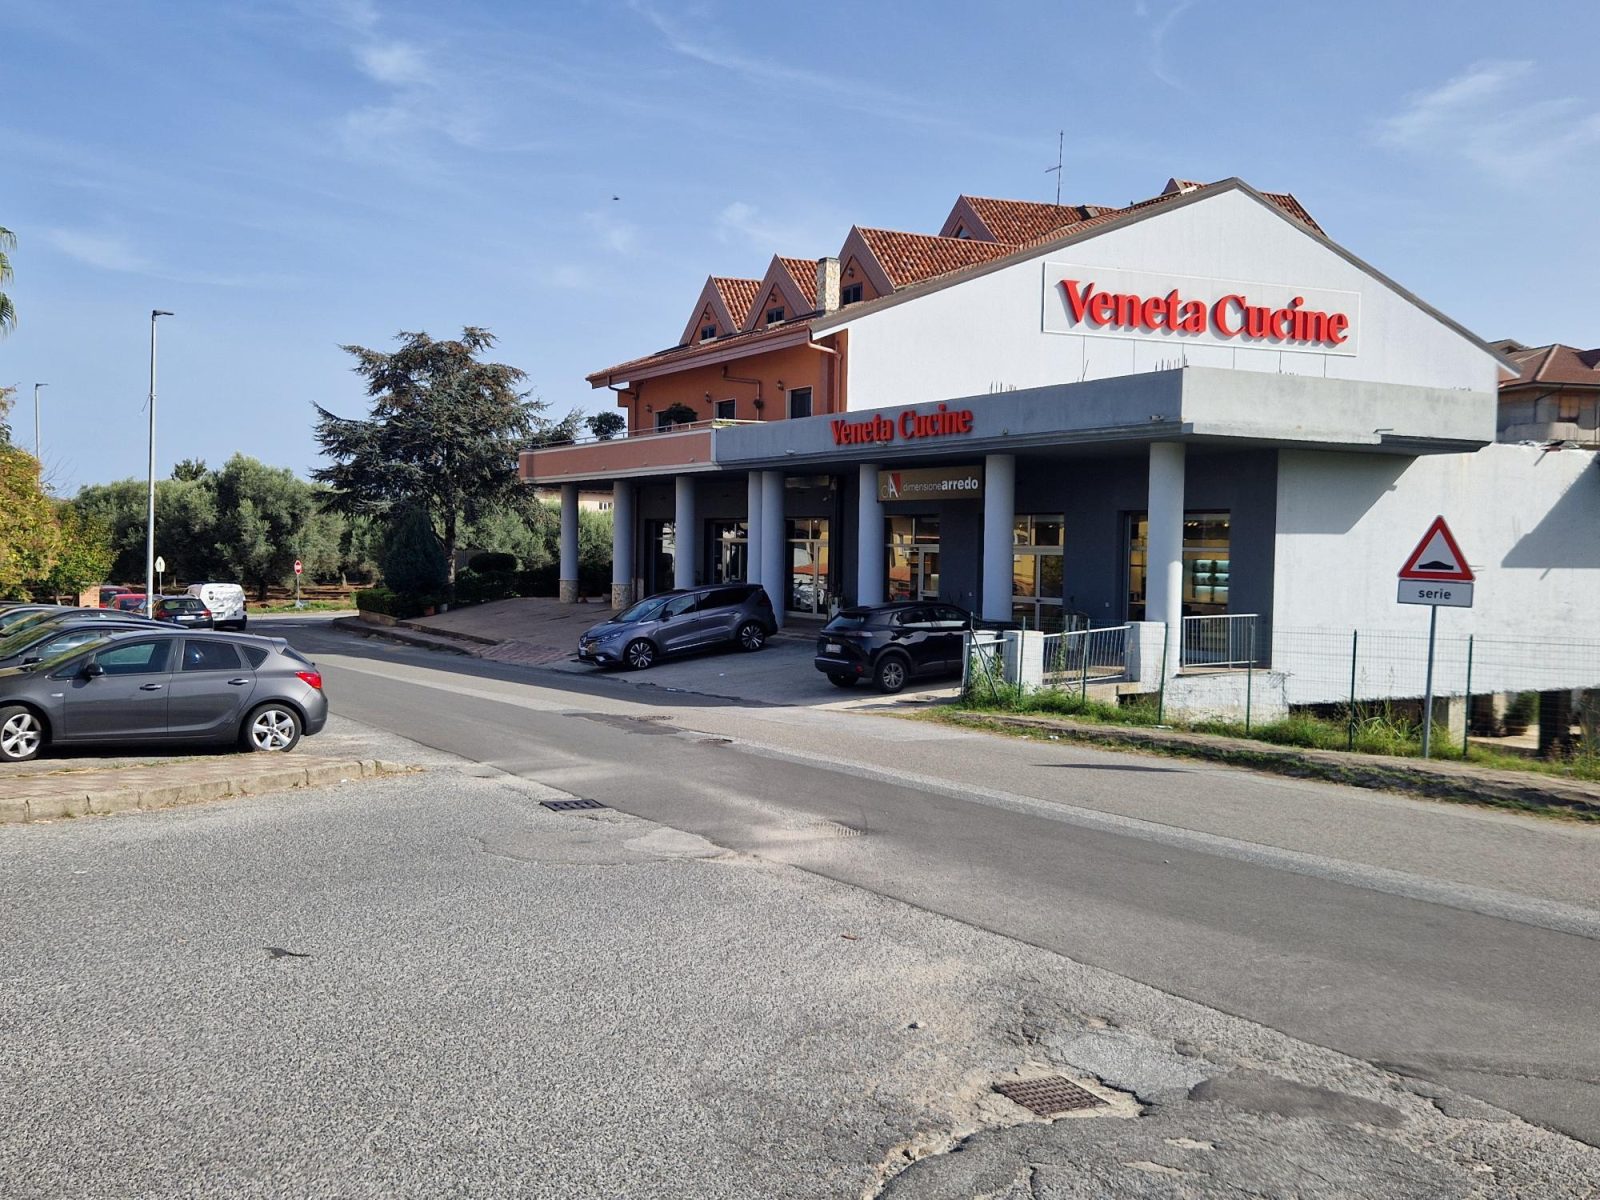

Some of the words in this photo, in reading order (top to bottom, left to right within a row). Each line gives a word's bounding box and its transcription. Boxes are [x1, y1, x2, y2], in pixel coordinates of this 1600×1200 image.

[1060, 280, 1207, 333] Veneta
[1212, 294, 1349, 344] Cucine
[831, 413, 894, 445] Veneta
[898, 403, 974, 439] Cucine
[1418, 588, 1452, 600] serie
